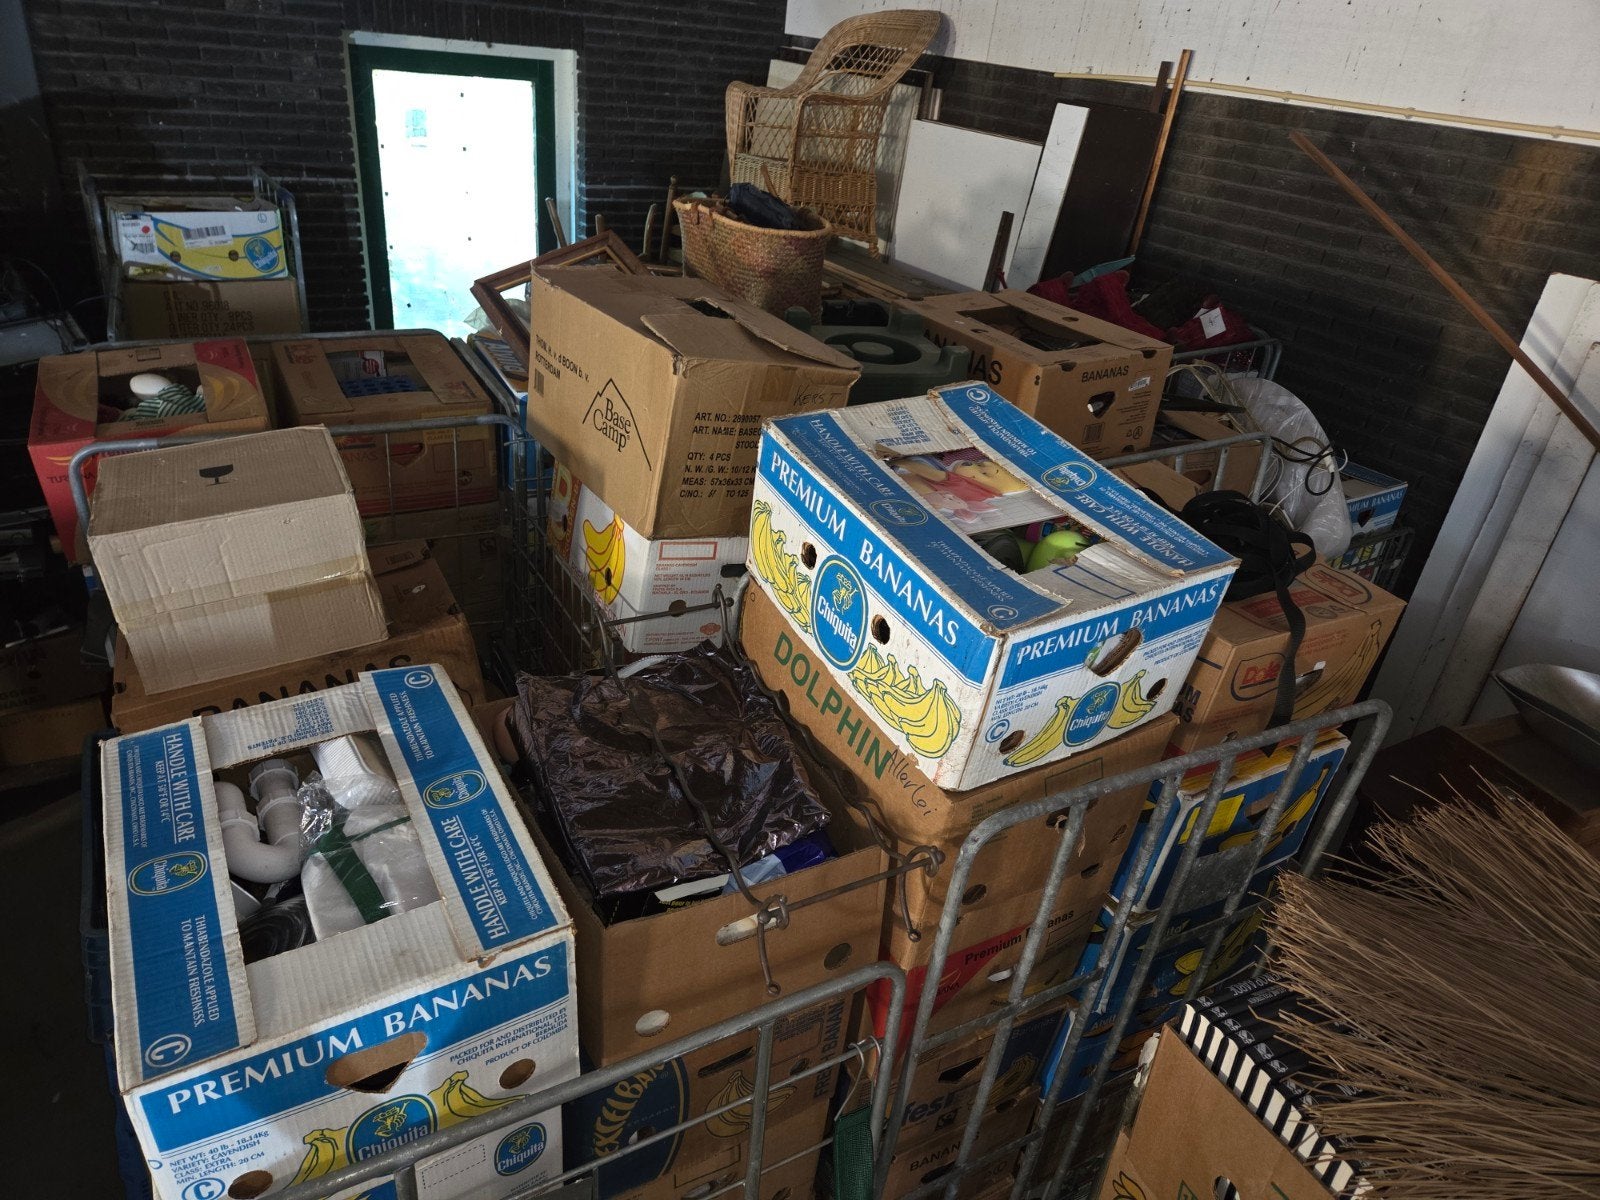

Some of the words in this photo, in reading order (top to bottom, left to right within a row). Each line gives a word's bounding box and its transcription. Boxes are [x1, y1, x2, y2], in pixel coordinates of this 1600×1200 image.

[535, 350, 561, 380] ROTTERDAM
[562, 357, 578, 378] BOON
[1081, 365, 1129, 383] BANANAS
[593, 408, 627, 453] Camp
[605, 398, 631, 434] Base
[712, 427, 737, 436] NAME:
[687, 452, 706, 461] QTY:
[715, 453, 732, 461] PCS
[811, 420, 848, 455] HANDLE
[846, 453, 872, 478] WITH
[682, 478, 706, 486] MEAS:
[1105, 513, 1140, 535] WITH
[771, 451, 847, 541] PREMIUM
[859, 538, 960, 647] BANANAS
[816, 594, 859, 650] Chiquita
[1016, 617, 1120, 666] PREMIUM
[1130, 583, 1219, 626] BANANAS
[774, 631, 893, 781] DOLPHIN
[1068, 707, 1111, 732] Chiquita
[247, 738, 278, 751] PATENTS
[288, 735, 308, 743] MORE
[155, 760, 166, 774] KEEP
[166, 733, 188, 779] HANDLE
[171, 781, 192, 812] WITH
[452, 774, 471, 800] Chiquita
[175, 813, 196, 843] CARE
[440, 816, 467, 849] CARE
[153, 858, 169, 890] Chiquita
[453, 850, 481, 886] WITH
[493, 888, 508, 906] KEEP
[181, 918, 193, 932] TO
[469, 887, 507, 940] HANDLE
[182, 932, 198, 976] MAINTAIN
[964, 934, 1022, 965] Premium
[195, 914, 215, 984] THIABENDAZOLE
[205, 984, 220, 1021] APPLIED
[167, 1026, 365, 1115] PREMIUM
[383, 955, 552, 1037] BANANAS
[450, 1046, 478, 1062] PACKED
[479, 1039, 495, 1050] FOR
[496, 1032, 512, 1042] AND
[513, 1011, 558, 1036] DISTRIBUTED
[457, 1046, 494, 1066] CHIQUITA
[495, 1021, 553, 1049] INTERNATIONAL,
[535, 1018, 568, 1038] BERMUDA
[485, 1046, 519, 1066] PRODUCT
[532, 1024, 568, 1045] COLOMBIA
[169, 1157, 186, 1168] NET
[188, 1151, 206, 1162] WT:
[208, 1147, 219, 1155] 40
[220, 1142, 229, 1151] lb
[171, 1158, 210, 1173] VARIETY:
[211, 1139, 261, 1160] CAVENDISH
[357, 1124, 429, 1161] Chiquita
[497, 1141, 544, 1171] Chiquita
[174, 1167, 203, 1180] CLASS:
[204, 1157, 232, 1170] EXTRA
[176, 1175, 198, 1185] MIN.
[199, 1161, 237, 1178] LENGTH:
[239, 1157, 249, 1165] 20
[250, 1151, 265, 1160] CM
